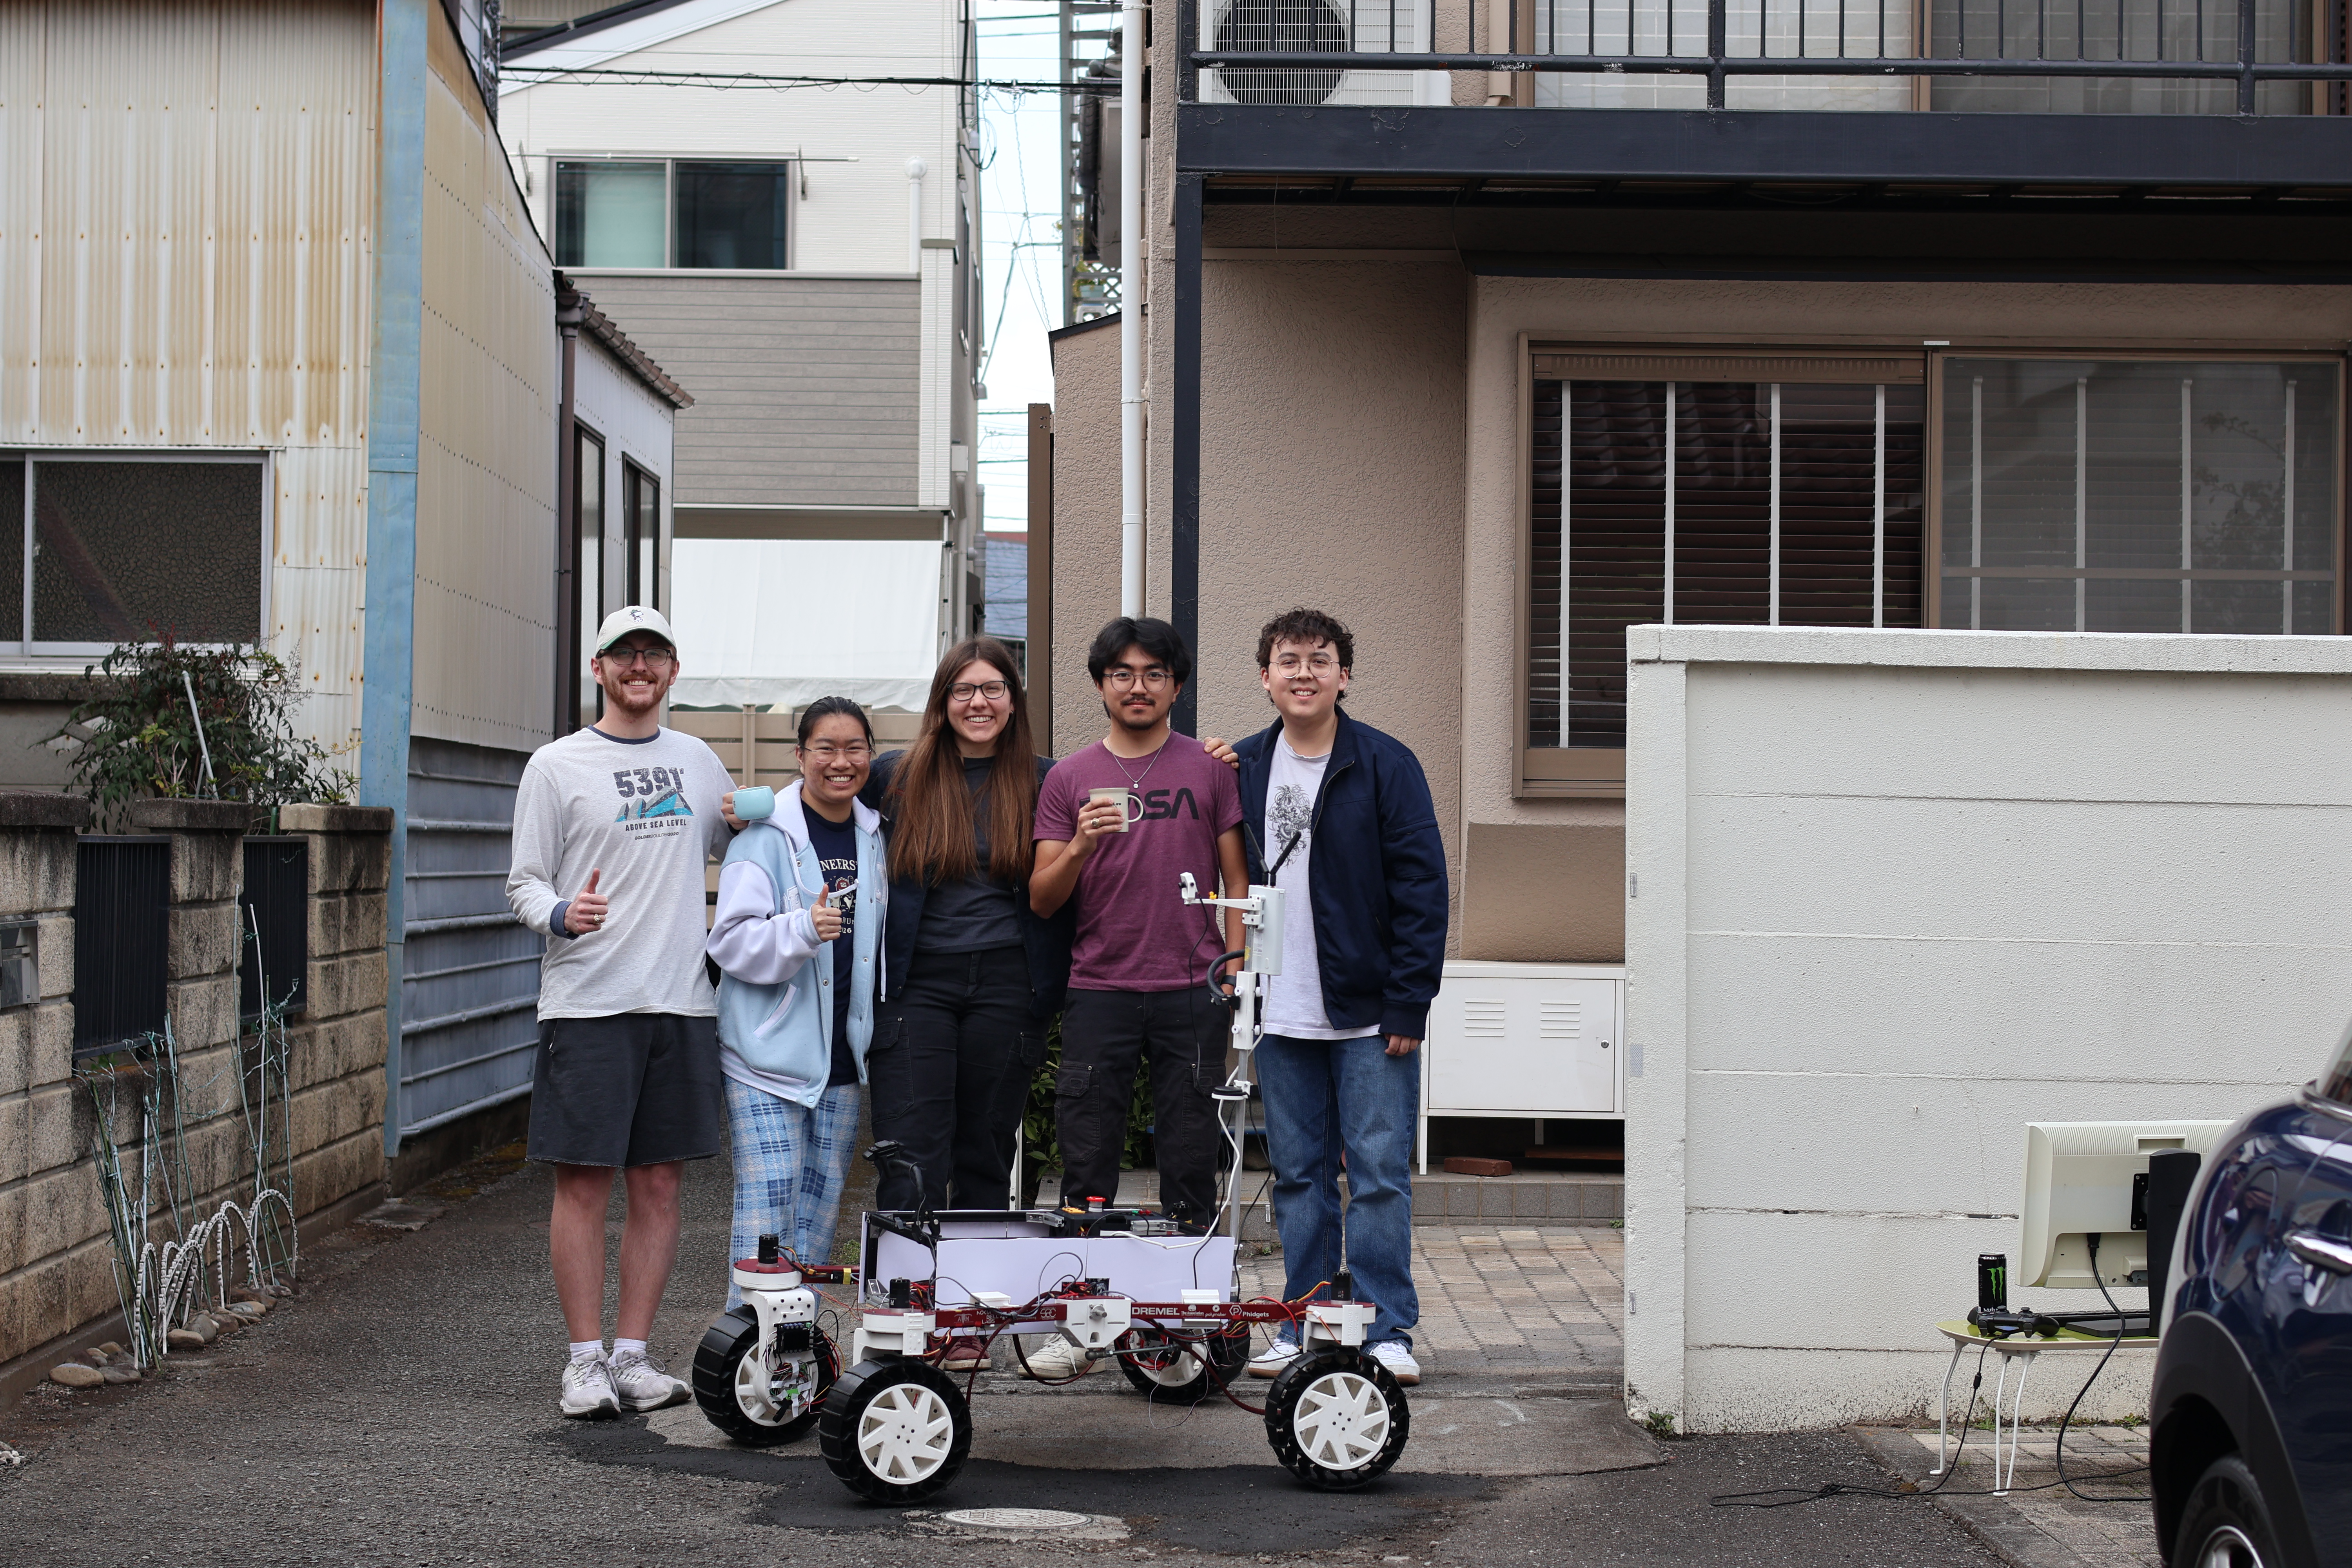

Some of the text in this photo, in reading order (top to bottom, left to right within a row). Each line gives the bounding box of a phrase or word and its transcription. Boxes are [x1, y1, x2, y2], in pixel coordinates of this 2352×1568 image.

[1079, 787, 1200, 821] ASA
[625, 822, 647, 831] ABOVE
[666, 818, 686, 827] LEVEL
[1132, 1307, 1180, 1316] DREMEL
